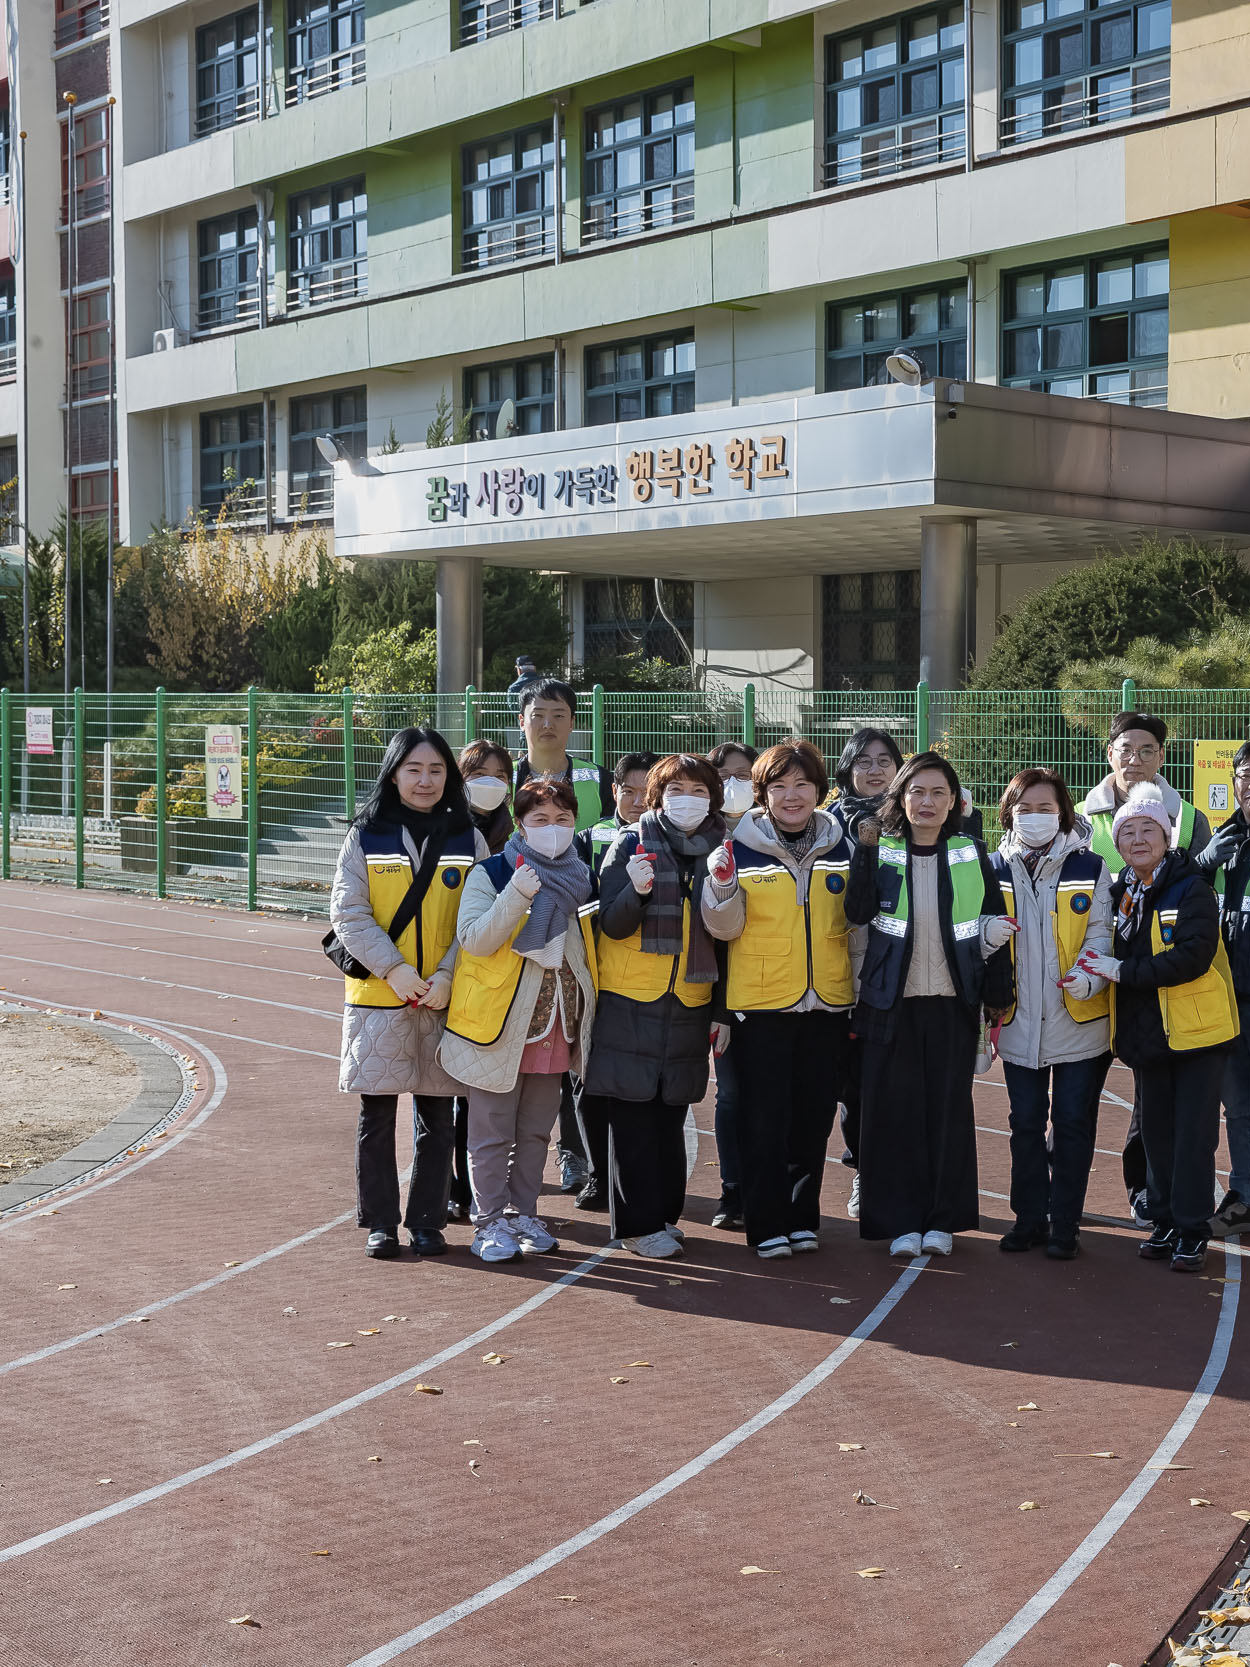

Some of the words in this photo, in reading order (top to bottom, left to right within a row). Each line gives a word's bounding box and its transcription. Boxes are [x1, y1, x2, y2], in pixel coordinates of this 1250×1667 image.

[425, 476, 468, 521] 꿈과
[475, 467, 545, 515] 사랑이
[554, 464, 618, 507] 가득한
[625, 443, 715, 502] 행복한
[725, 435, 789, 491] 학교
